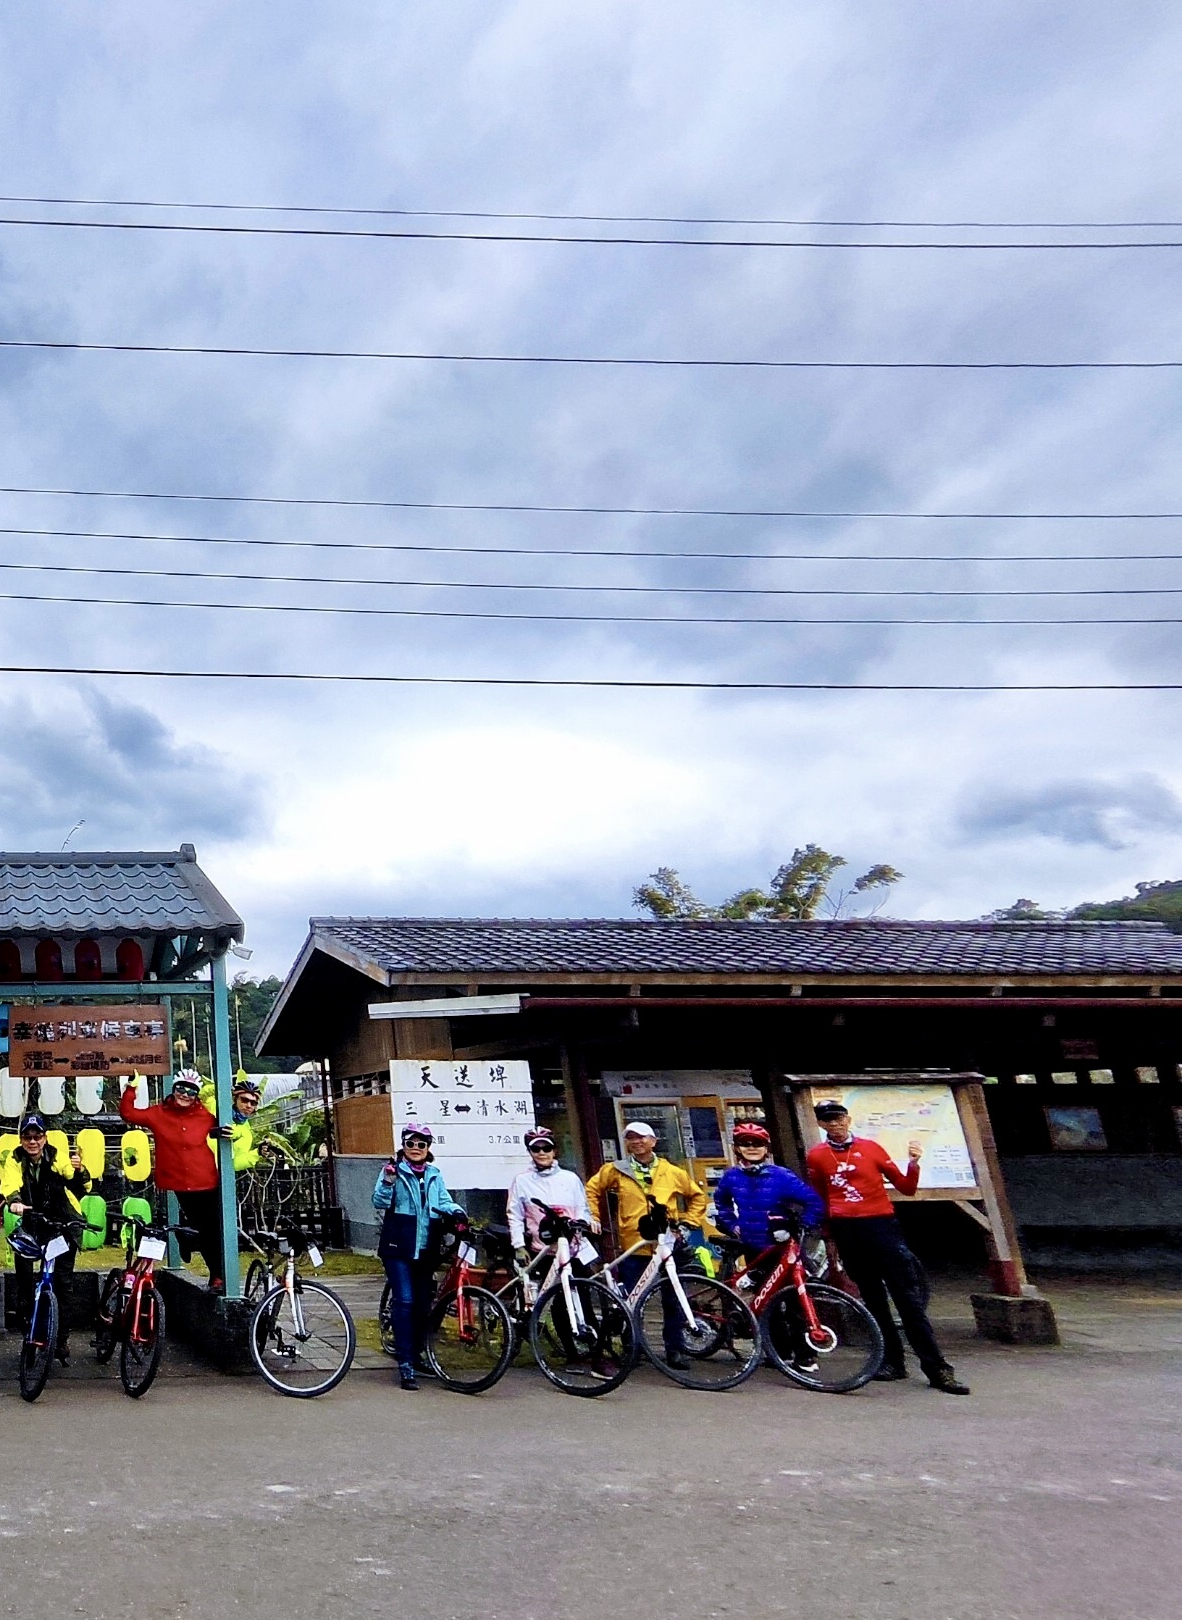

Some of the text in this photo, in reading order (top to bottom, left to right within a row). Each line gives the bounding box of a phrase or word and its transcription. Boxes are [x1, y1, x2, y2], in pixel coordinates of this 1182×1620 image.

[419, 1064, 508, 1089] 天送埤
[405, 1099, 452, 1117] 三星
[476, 1099, 528, 1117] 清水湖
[488, 1135, 521, 1145] 3.7公里
[753, 1263, 785, 1310] DOSUN
